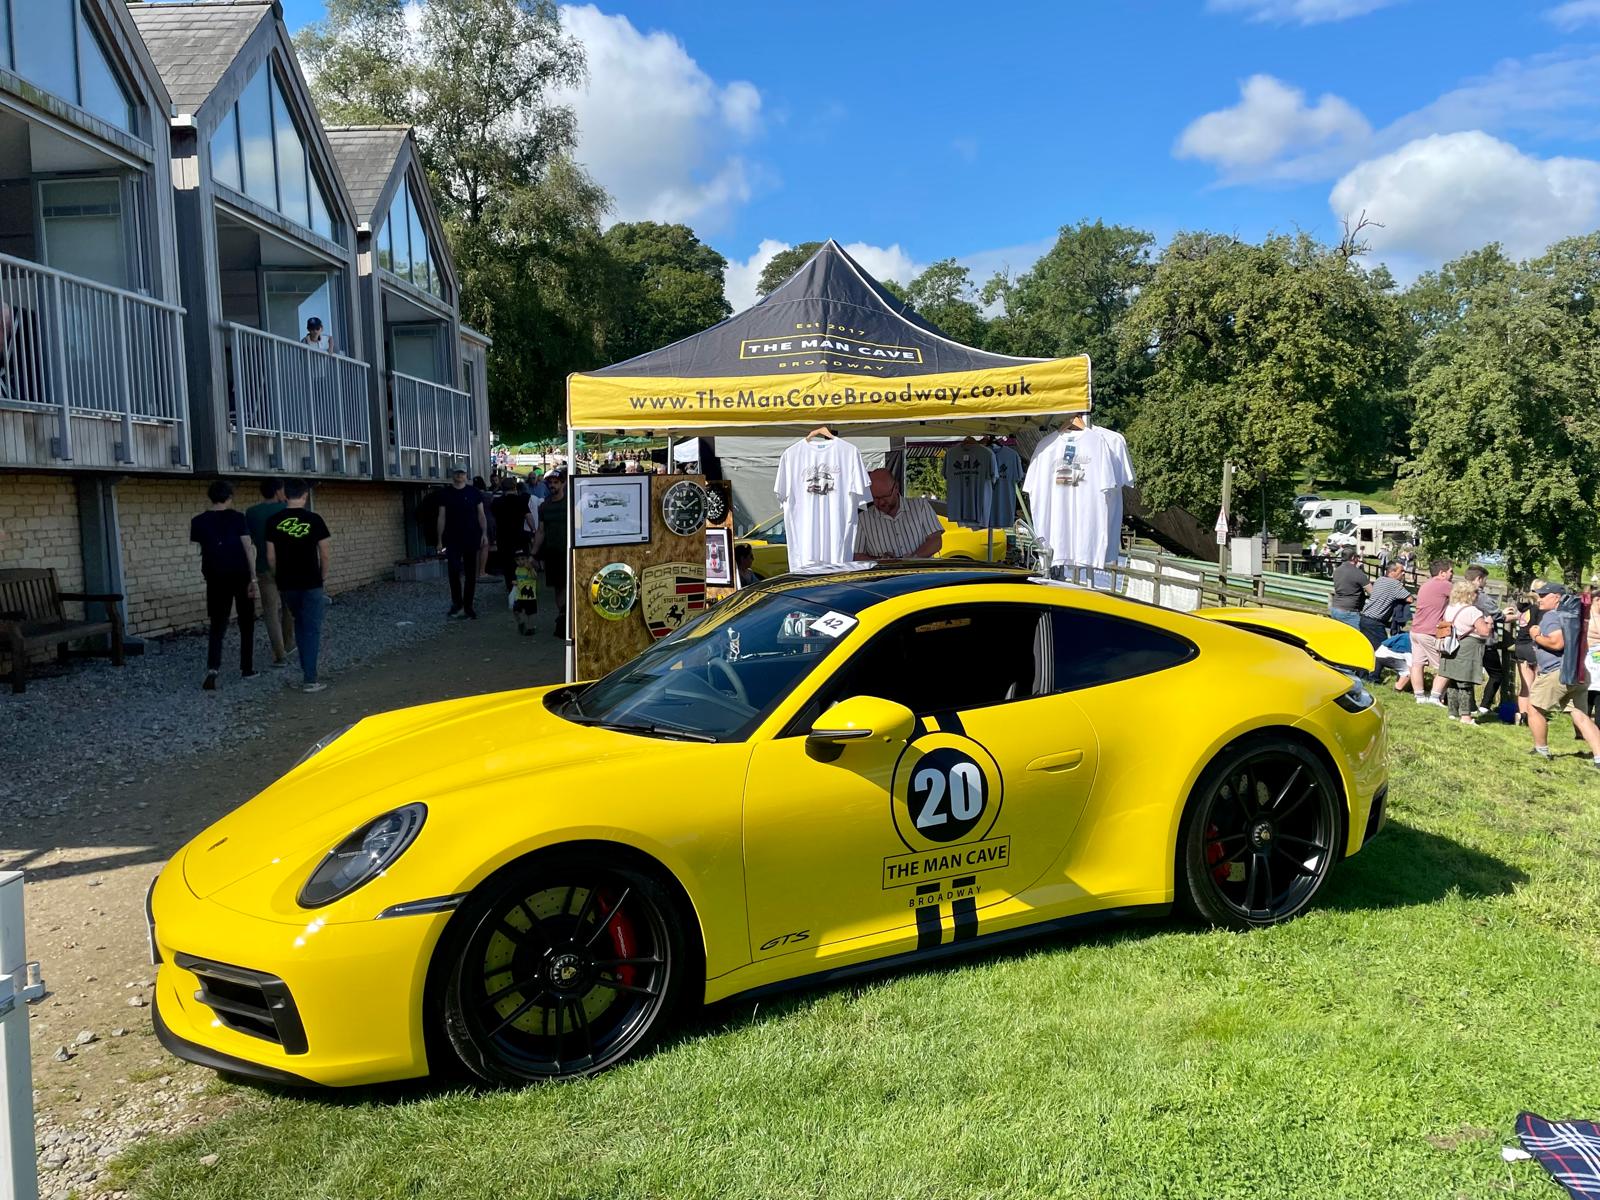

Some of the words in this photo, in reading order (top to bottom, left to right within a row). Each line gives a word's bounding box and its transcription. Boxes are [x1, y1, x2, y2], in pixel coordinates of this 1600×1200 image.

[828, 324, 865, 336] 2017
[748, 341, 793, 354] THE
[801, 339, 850, 352] MAN
[857, 346, 915, 360] CAVE
[778, 359, 885, 371] BROADWAY
[629, 375, 1033, 410] www.TheManCaveBroadway.co.uk
[644, 566, 705, 579] PORSCHE
[823, 616, 844, 630] 42
[914, 762, 983, 828] 20
[886, 860, 919, 880] THE
[923, 853, 962, 874] MAN
[965, 844, 1008, 866] CAVE
[909, 885, 983, 908] BROADWAY
[760, 929, 811, 951] GTS
